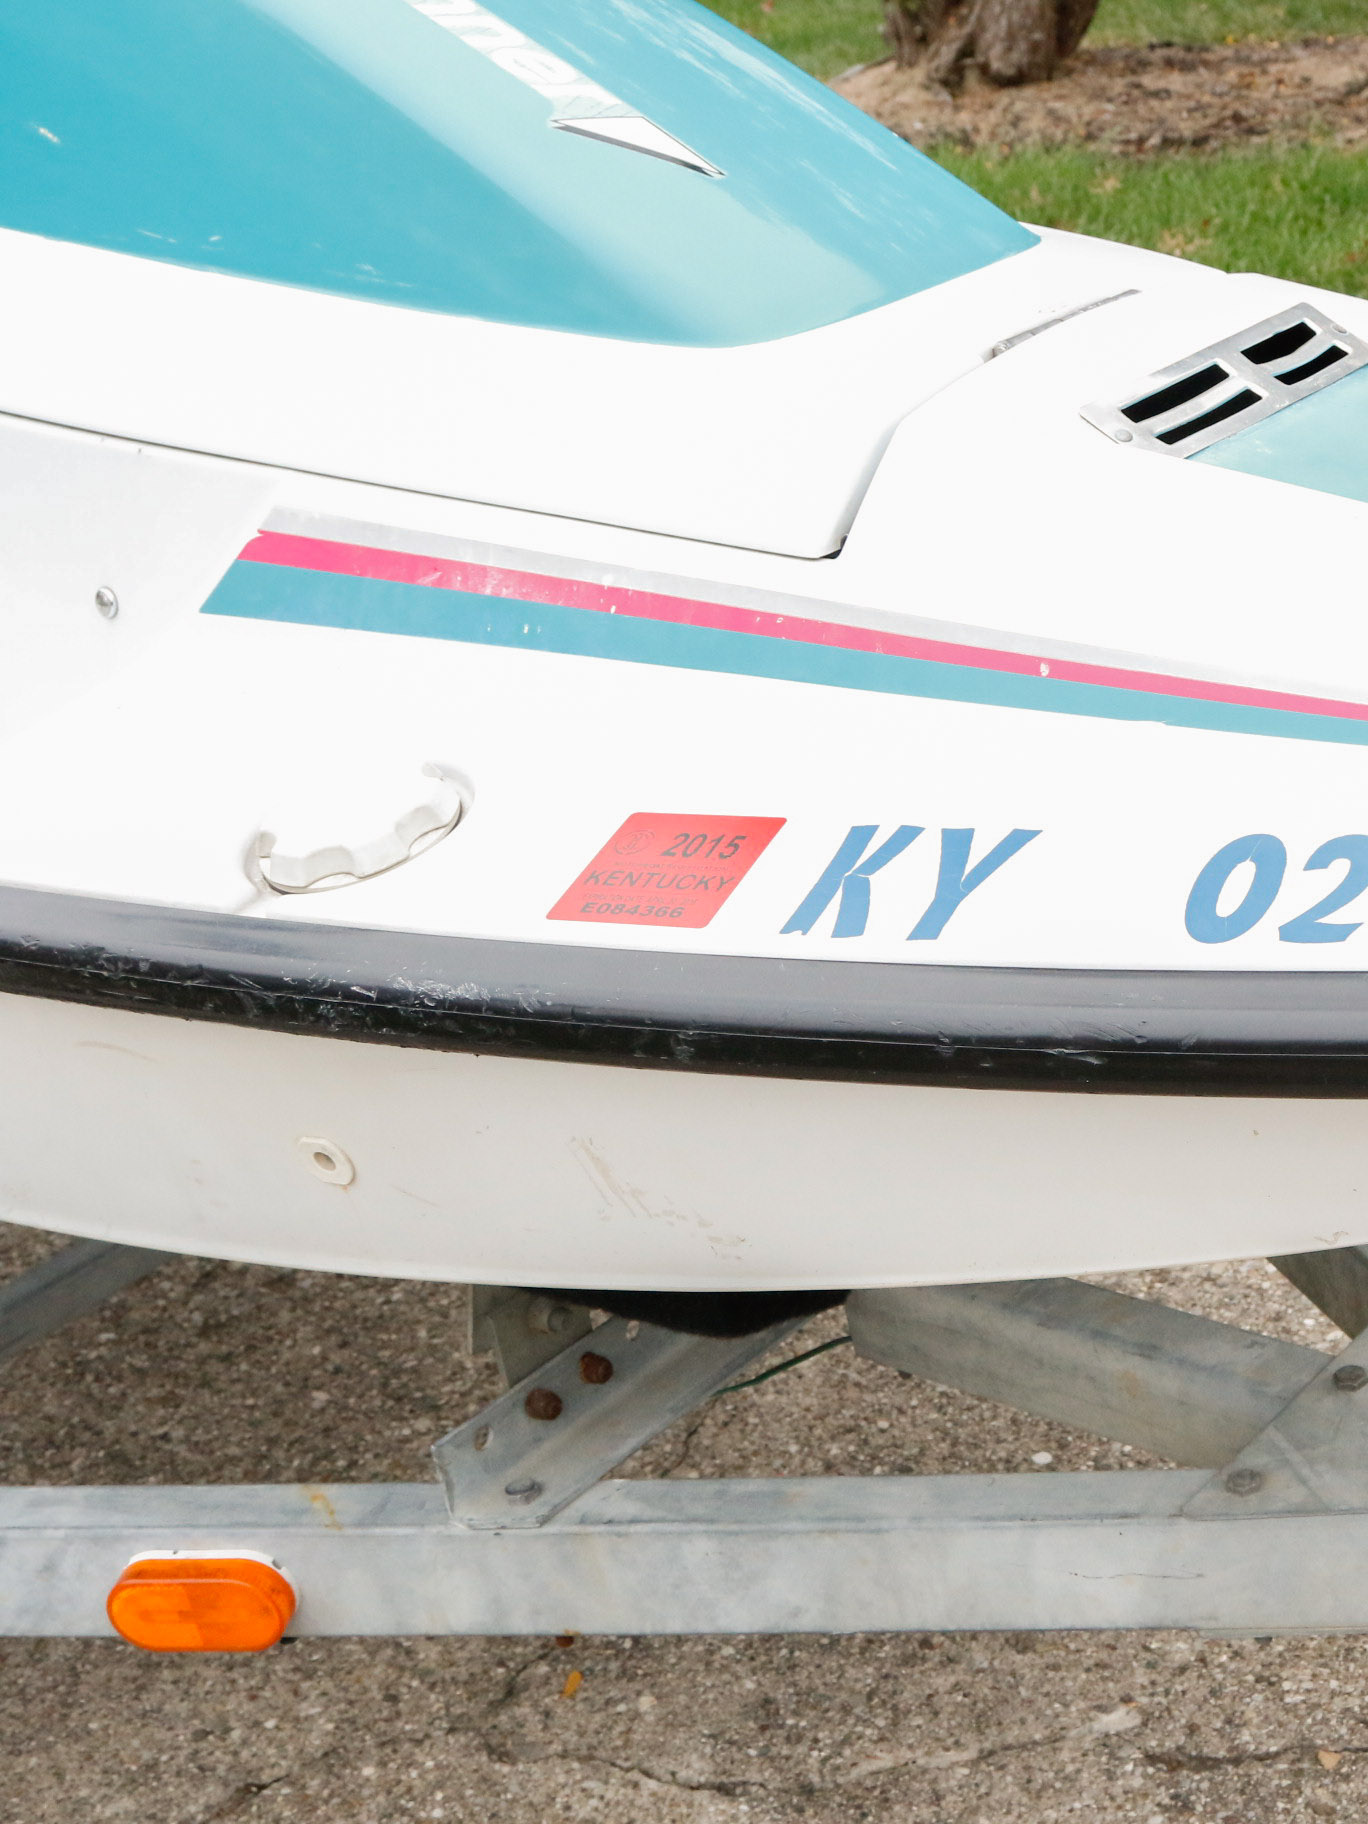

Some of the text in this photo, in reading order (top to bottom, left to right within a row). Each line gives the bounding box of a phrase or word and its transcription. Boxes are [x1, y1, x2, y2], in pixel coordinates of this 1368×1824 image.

[660, 833, 747, 859] 2015
[583, 870, 735, 891] KENTUCKY
[782, 826, 1040, 940] KY
[580, 902, 685, 918] E084366
